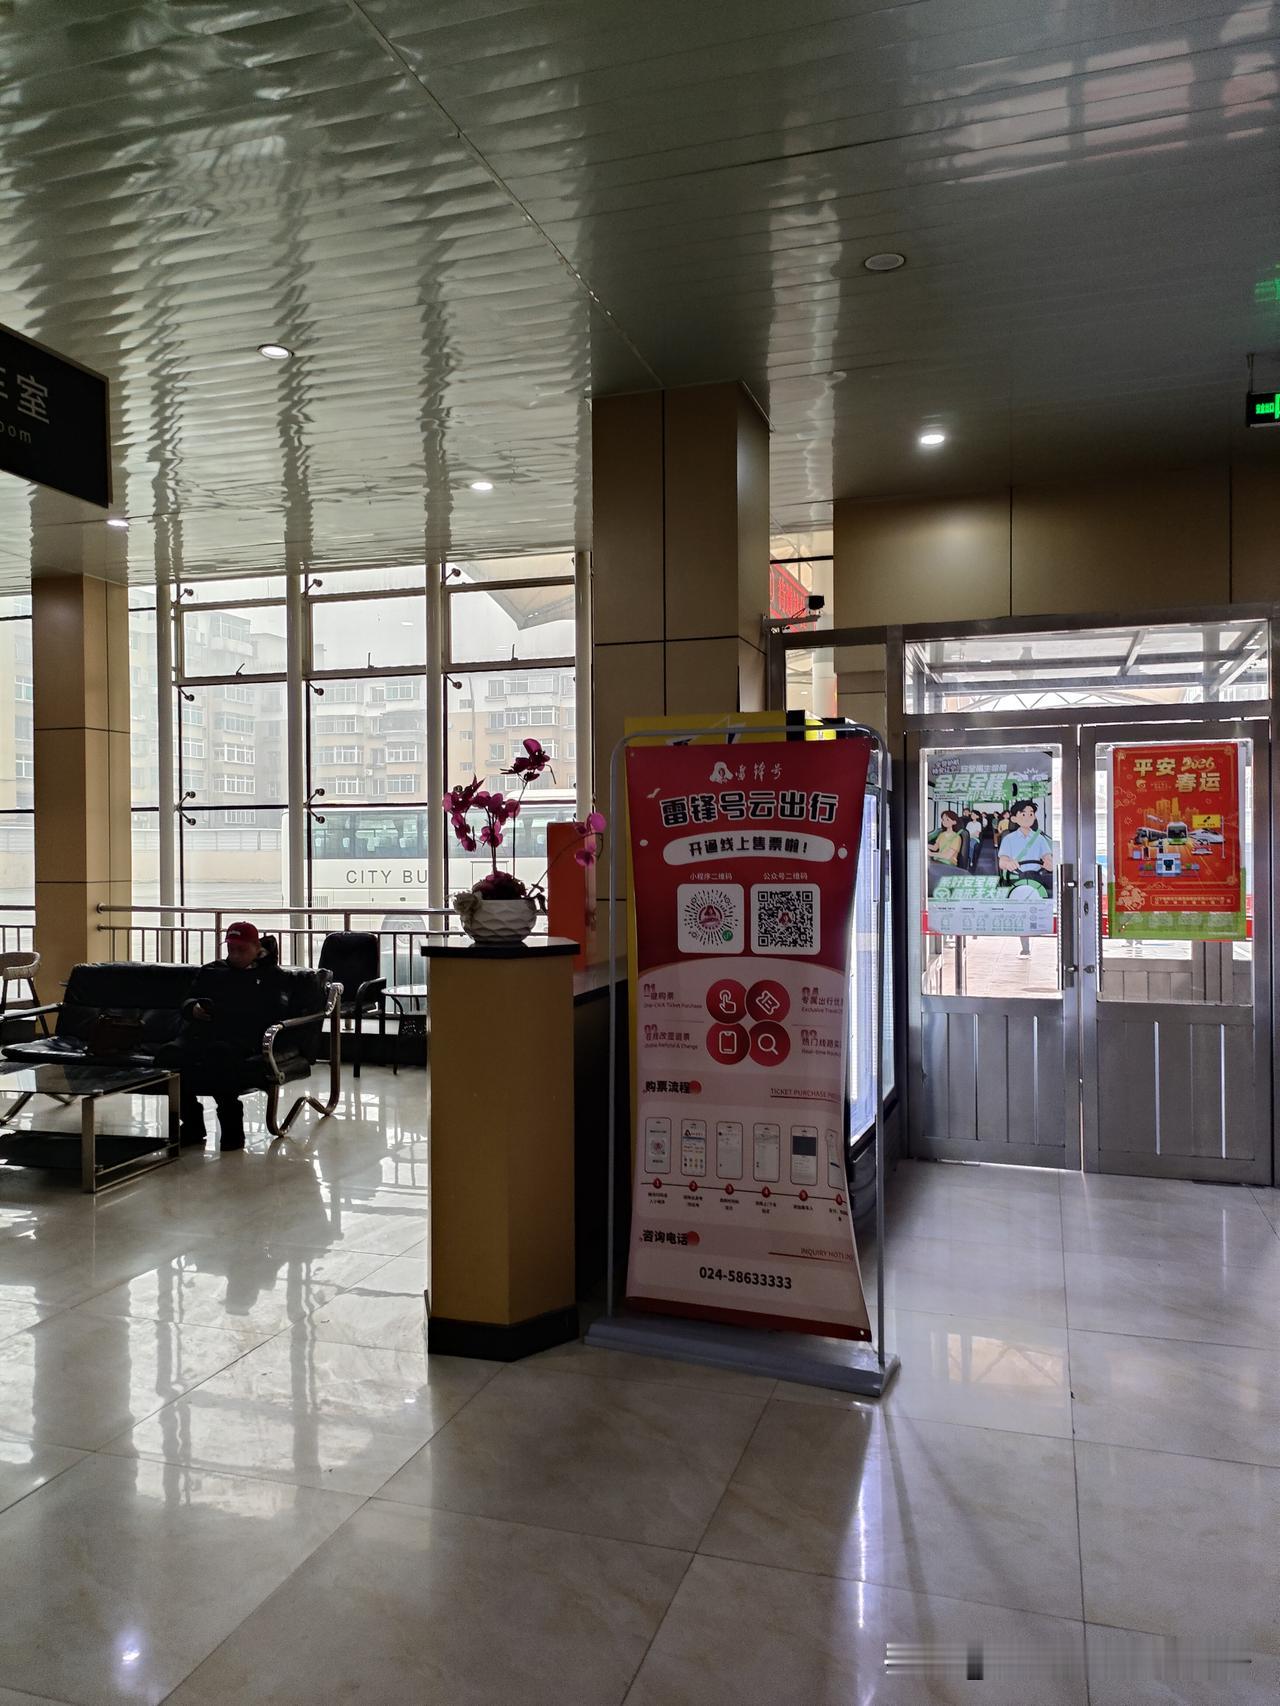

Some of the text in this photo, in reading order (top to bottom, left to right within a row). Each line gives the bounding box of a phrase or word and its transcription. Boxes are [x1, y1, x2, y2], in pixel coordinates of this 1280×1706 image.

[1133, 758, 1176, 776] 平安
[934, 773, 1009, 792] 全员全程
[1175, 773, 1220, 792] 春运
[659, 790, 839, 828] 雷锋号云出行
[346, 870, 392, 884] CITY
[690, 872, 733, 880] 小程序二维码
[763, 872, 808, 880] 公众号二维码
[801, 996, 844, 1007] 专属出行优
[645, 1080, 690, 1094] 购票流程
[770, 1088, 792, 1096] TICKET
[793, 1089, 827, 1098] PURCHASE
[642, 1229, 688, 1246] 咨询电话
[800, 1247, 828, 1257] INQUIRY
[699, 1266, 793, 1290] 024-58633333
